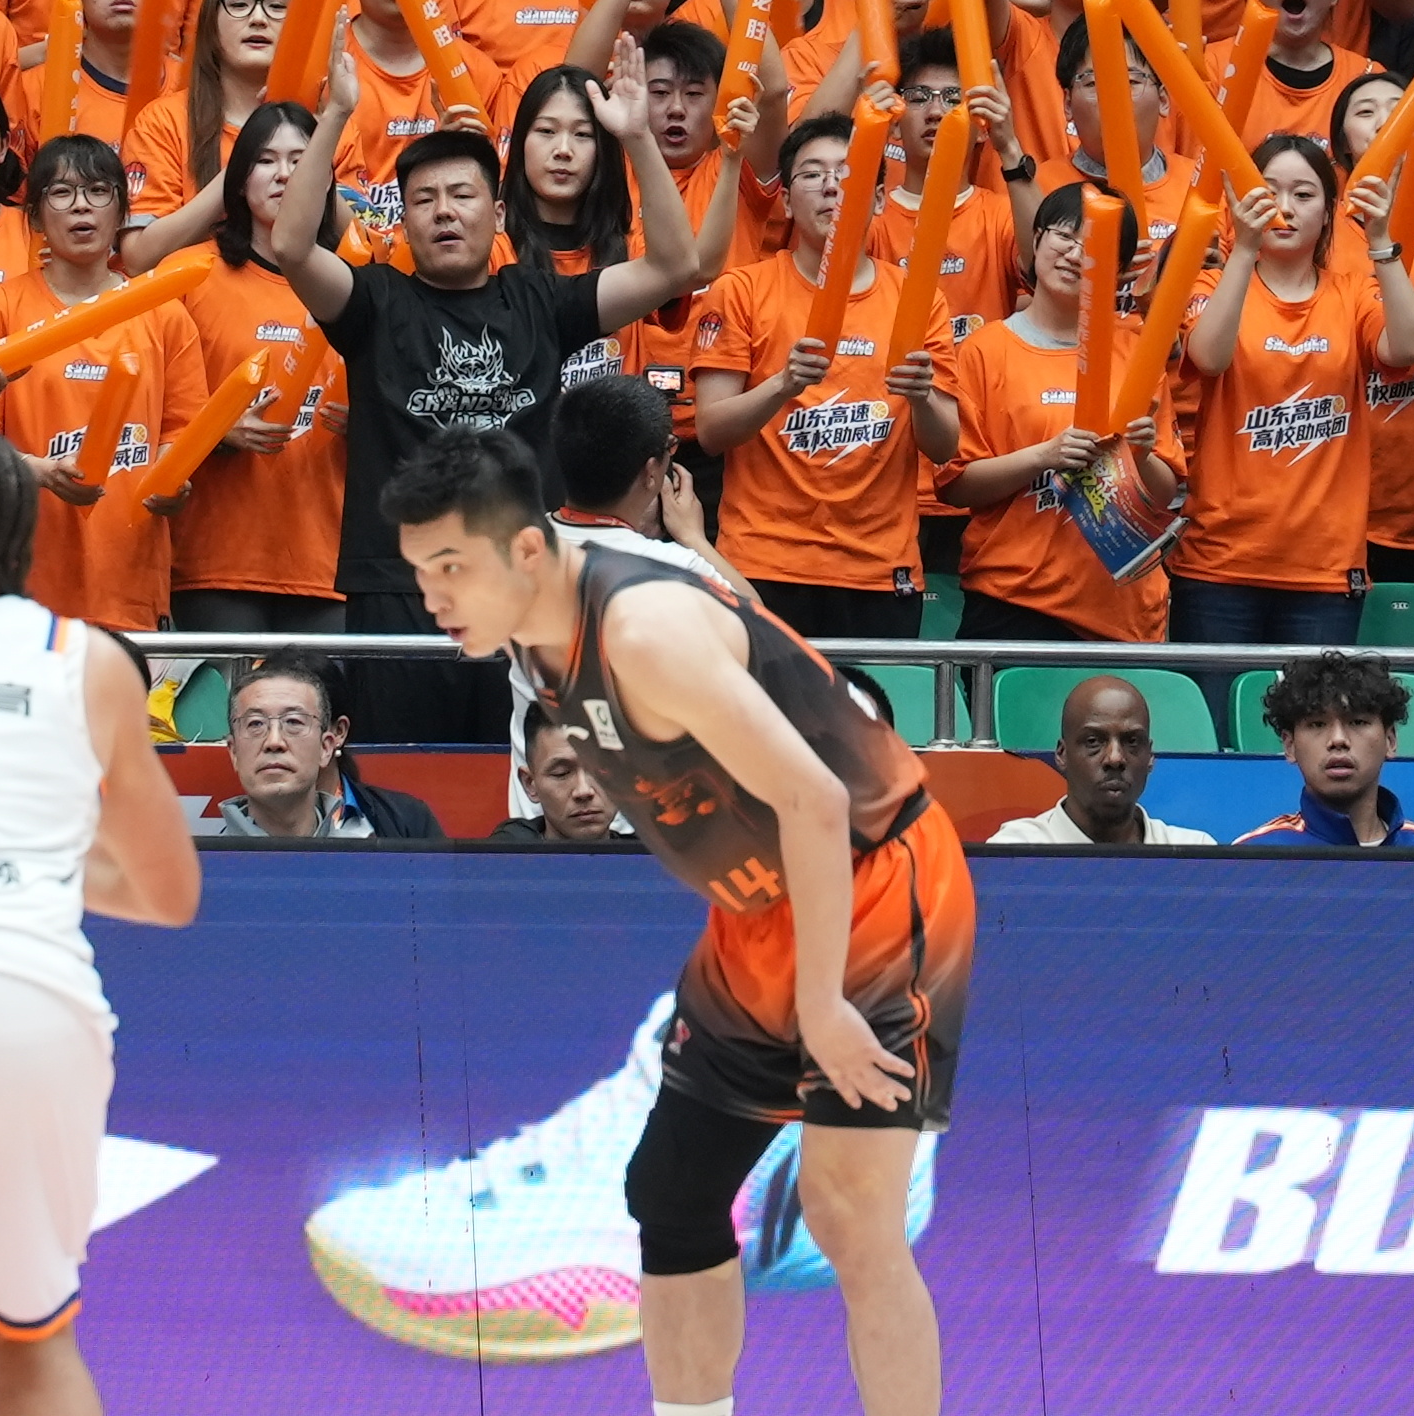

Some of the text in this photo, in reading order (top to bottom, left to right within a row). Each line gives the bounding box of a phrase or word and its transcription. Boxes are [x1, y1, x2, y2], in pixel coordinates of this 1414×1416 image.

[410, 389, 535, 416] SHANDONG
[786, 404, 871, 432] 山东高速
[790, 425, 890, 452] 高校助威团
[1244, 409, 1333, 445] 山东高速
[1253, 430, 1348, 465] 高校助威团
[709, 856, 781, 912] 14
